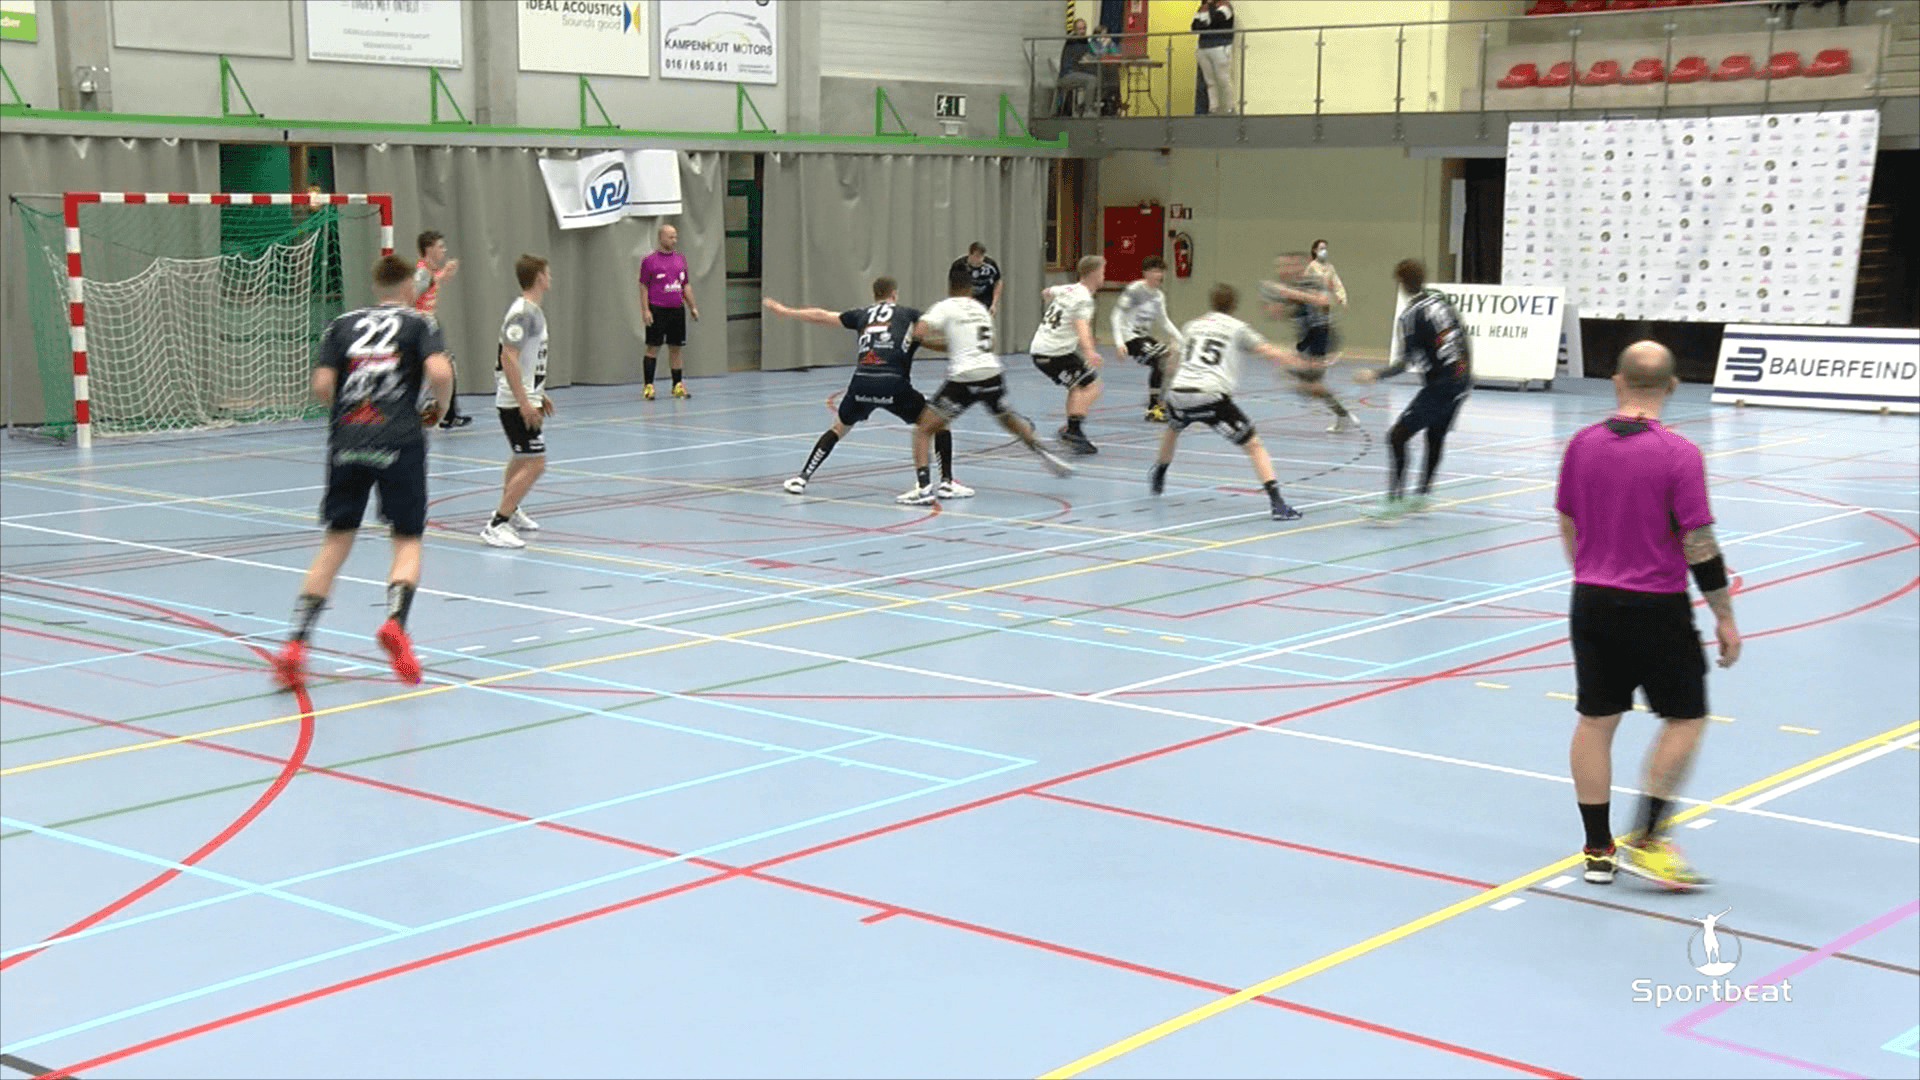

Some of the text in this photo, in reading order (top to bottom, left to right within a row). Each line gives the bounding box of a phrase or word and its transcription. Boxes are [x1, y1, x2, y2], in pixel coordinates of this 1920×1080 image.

[563, 1, 622, 16] ACOUSTICS
[562, 14, 621, 33] Sounds good
[664, 39, 773, 56] KAMPENHOUT MOTORS
[665, 59, 682, 70] 016
[1446, 293, 1559, 316] PHYTOVET
[346, 316, 401, 357] 22
[1489, 325, 1528, 338] HEALTH
[1185, 337, 1226, 366] 15
[1769, 357, 1917, 380] BAUERFEIND
